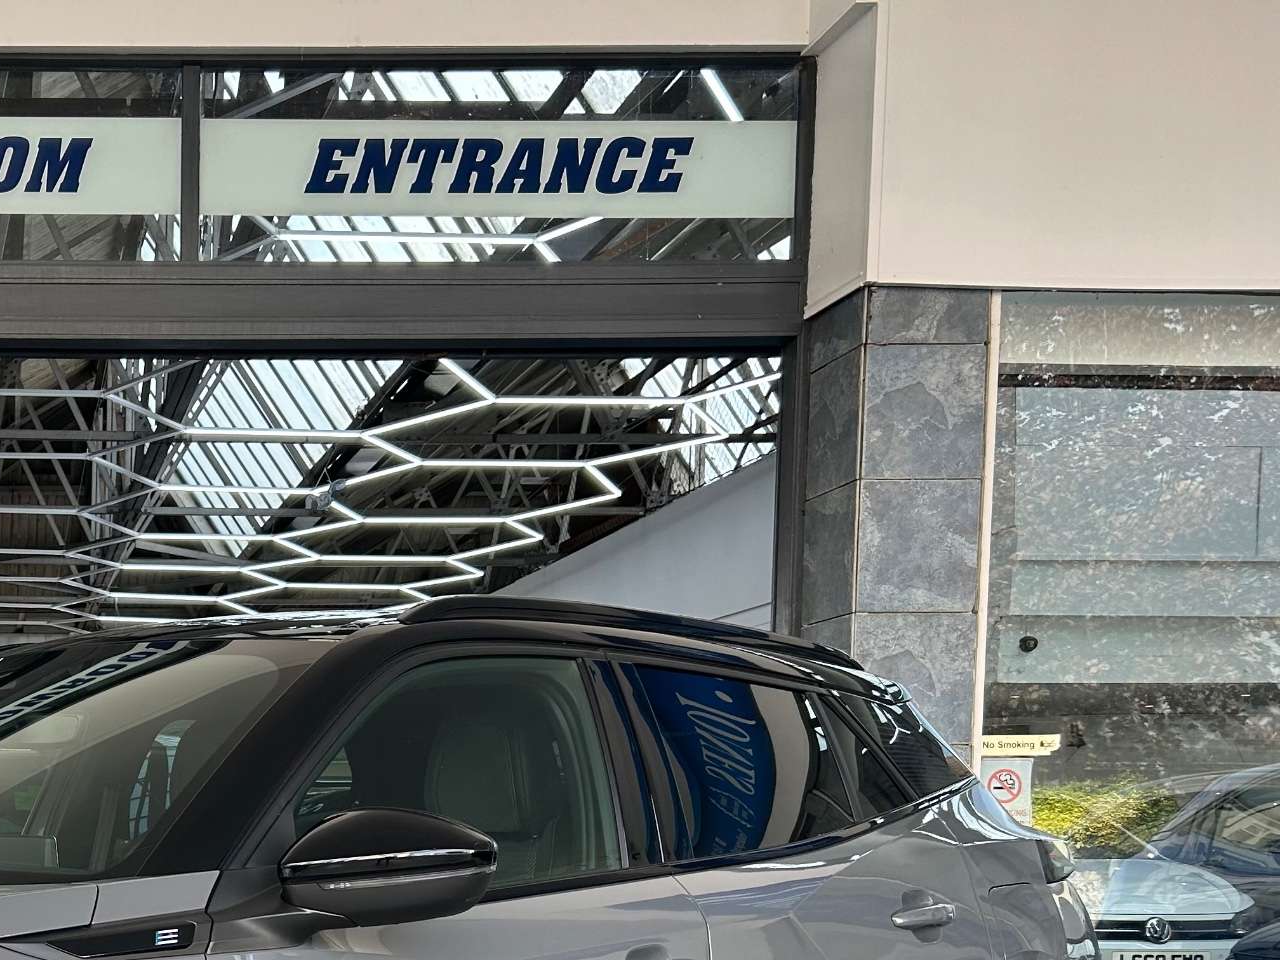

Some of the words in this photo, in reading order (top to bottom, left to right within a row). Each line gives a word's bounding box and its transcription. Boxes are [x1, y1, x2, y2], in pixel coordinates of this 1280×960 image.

[303, 136, 695, 195] ENTRANCE
[982, 741, 995, 749] No
[997, 741, 1035, 750] Smoking
